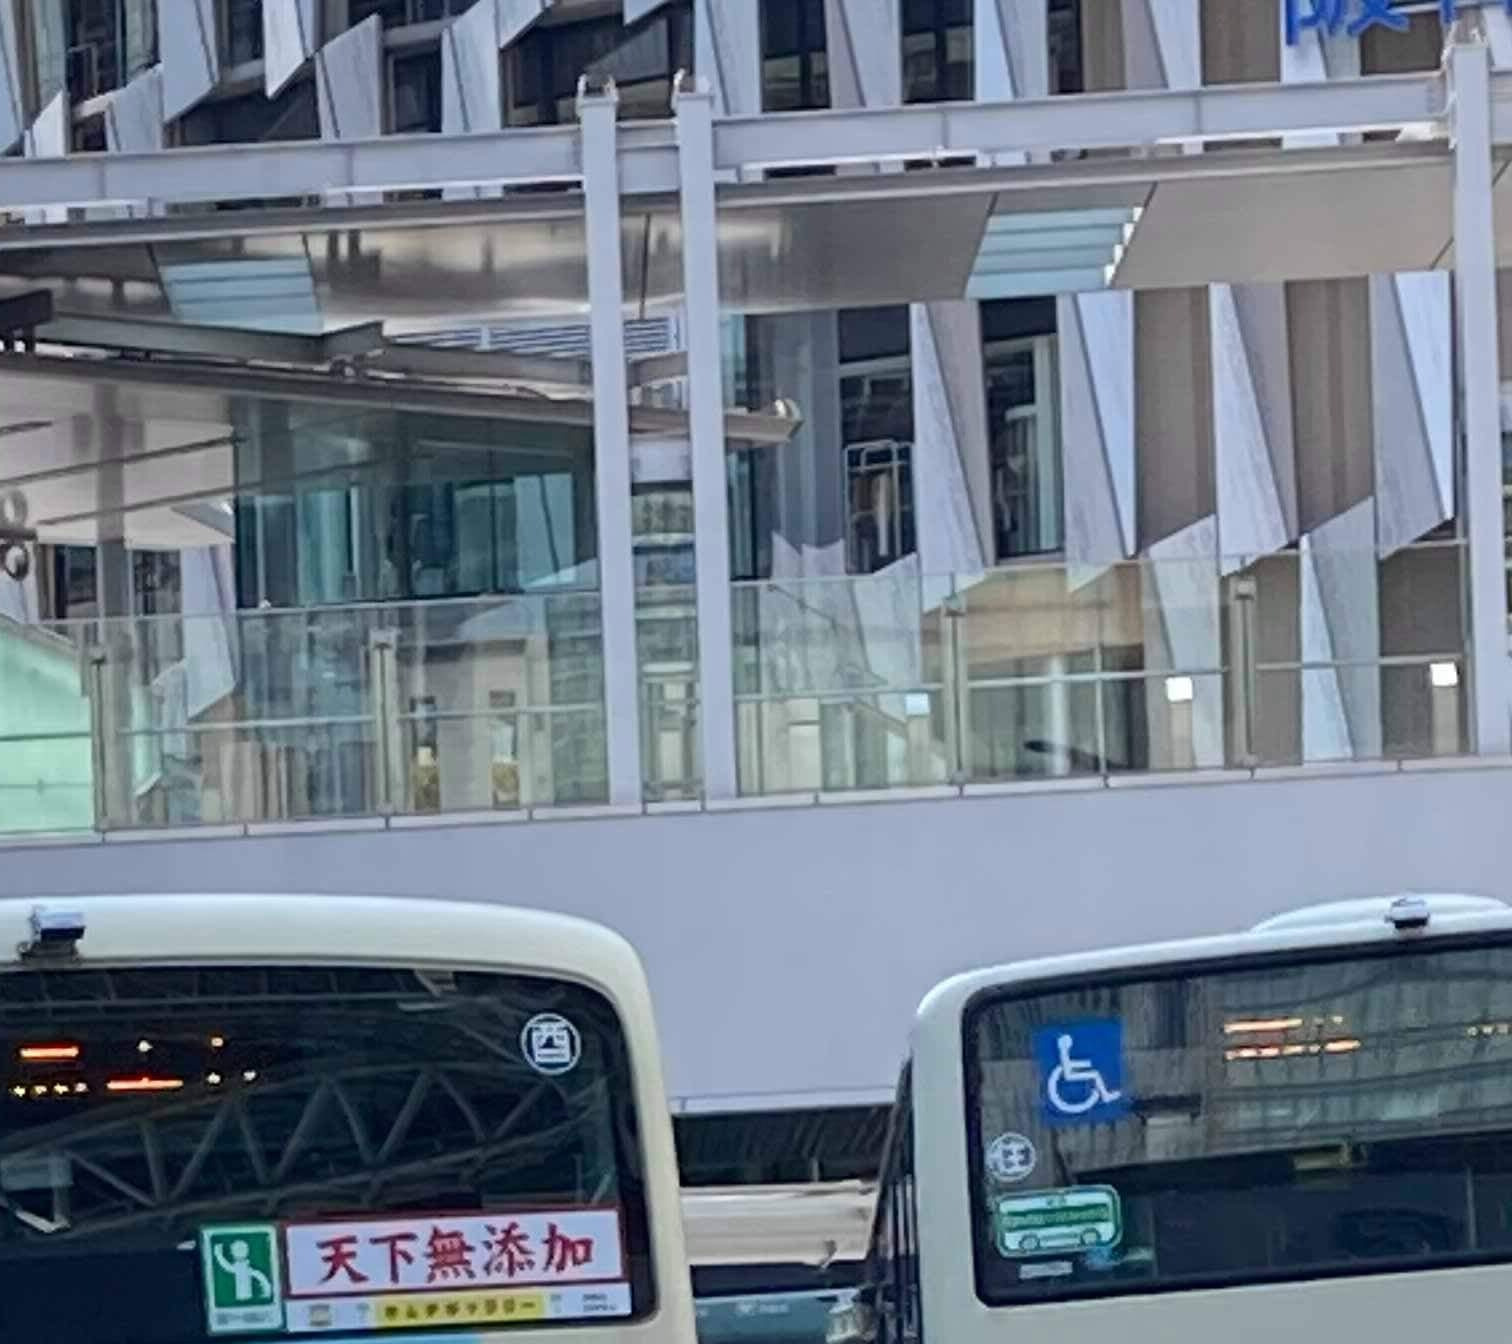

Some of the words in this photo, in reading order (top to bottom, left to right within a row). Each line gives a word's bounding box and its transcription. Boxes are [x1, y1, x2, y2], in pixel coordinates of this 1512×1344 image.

[317, 1221, 594, 1285] 天下無添加
